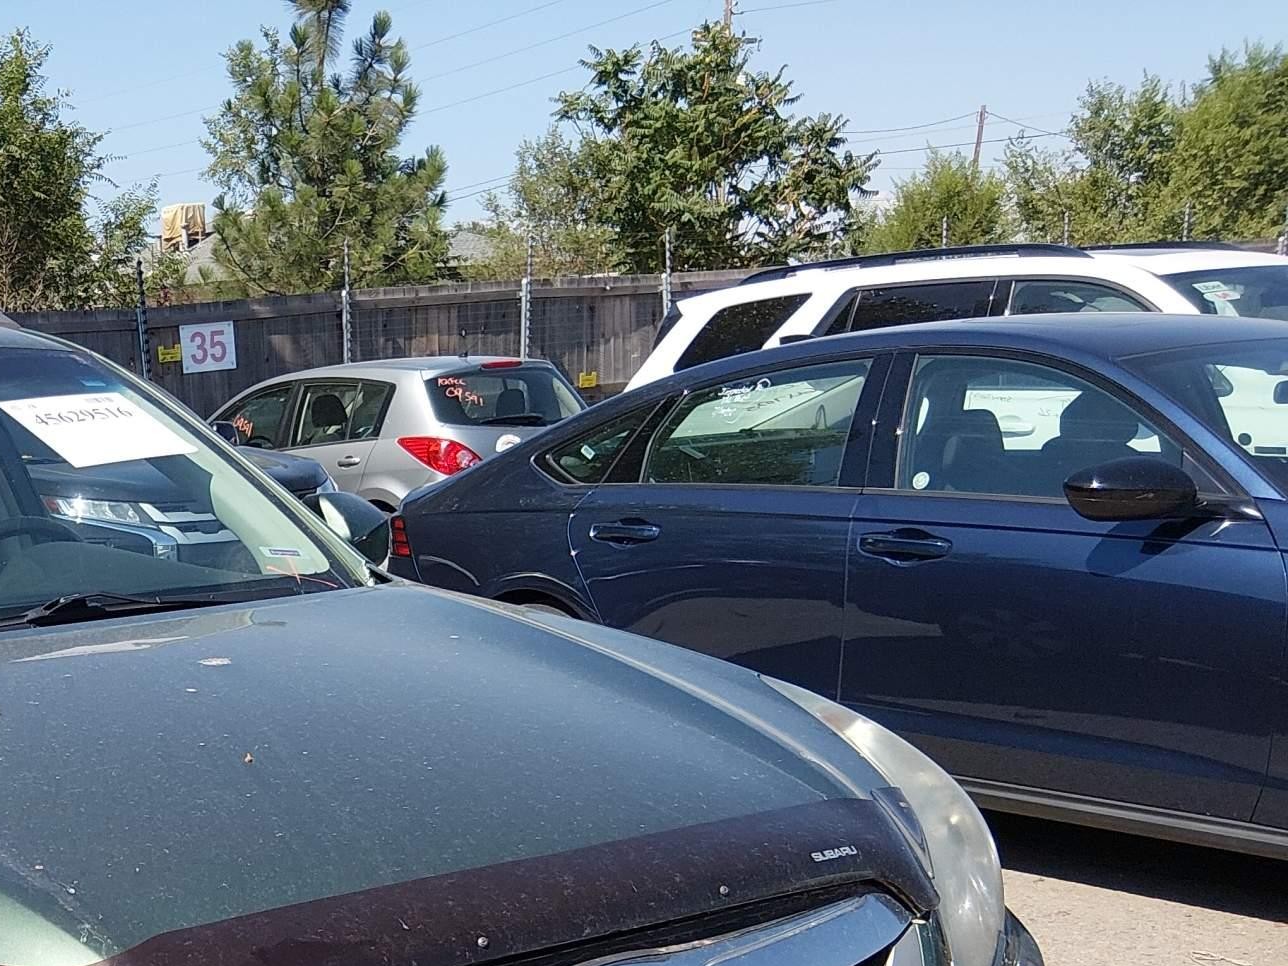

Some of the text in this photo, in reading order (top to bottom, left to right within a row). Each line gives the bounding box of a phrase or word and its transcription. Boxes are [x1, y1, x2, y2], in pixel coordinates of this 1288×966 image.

[190, 329, 227, 365] 35
[35, 406, 134, 426] 45629516
[810, 845, 858, 862] SUBARU
